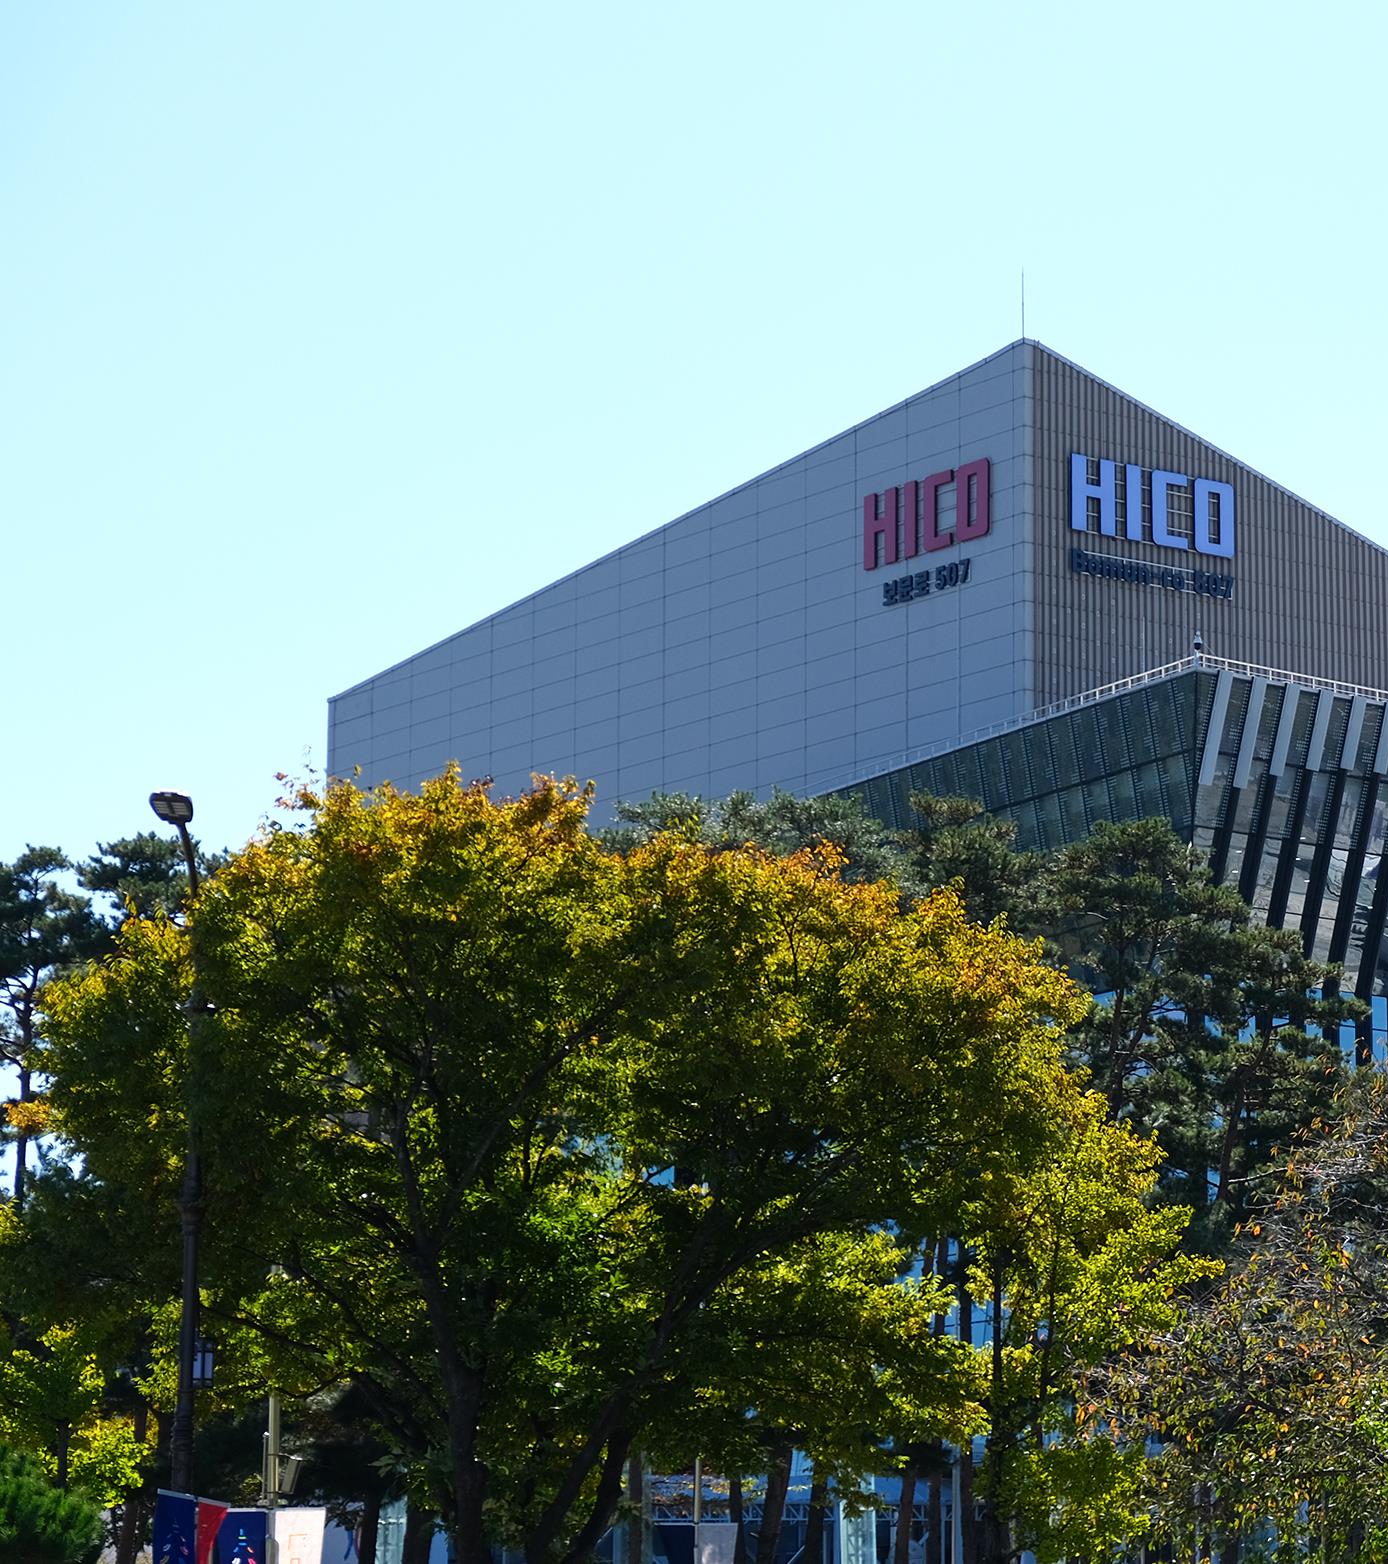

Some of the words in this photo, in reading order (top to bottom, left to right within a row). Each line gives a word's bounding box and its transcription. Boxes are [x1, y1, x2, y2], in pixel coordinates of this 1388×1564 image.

[864, 457, 990, 571] HICO
[1070, 453, 1235, 559] HICO
[882, 570, 930, 606] 보문로
[935, 558, 971, 590] 507
[1072, 549, 1185, 591] Bomun-ro
[1194, 569, 1234, 599] 507
